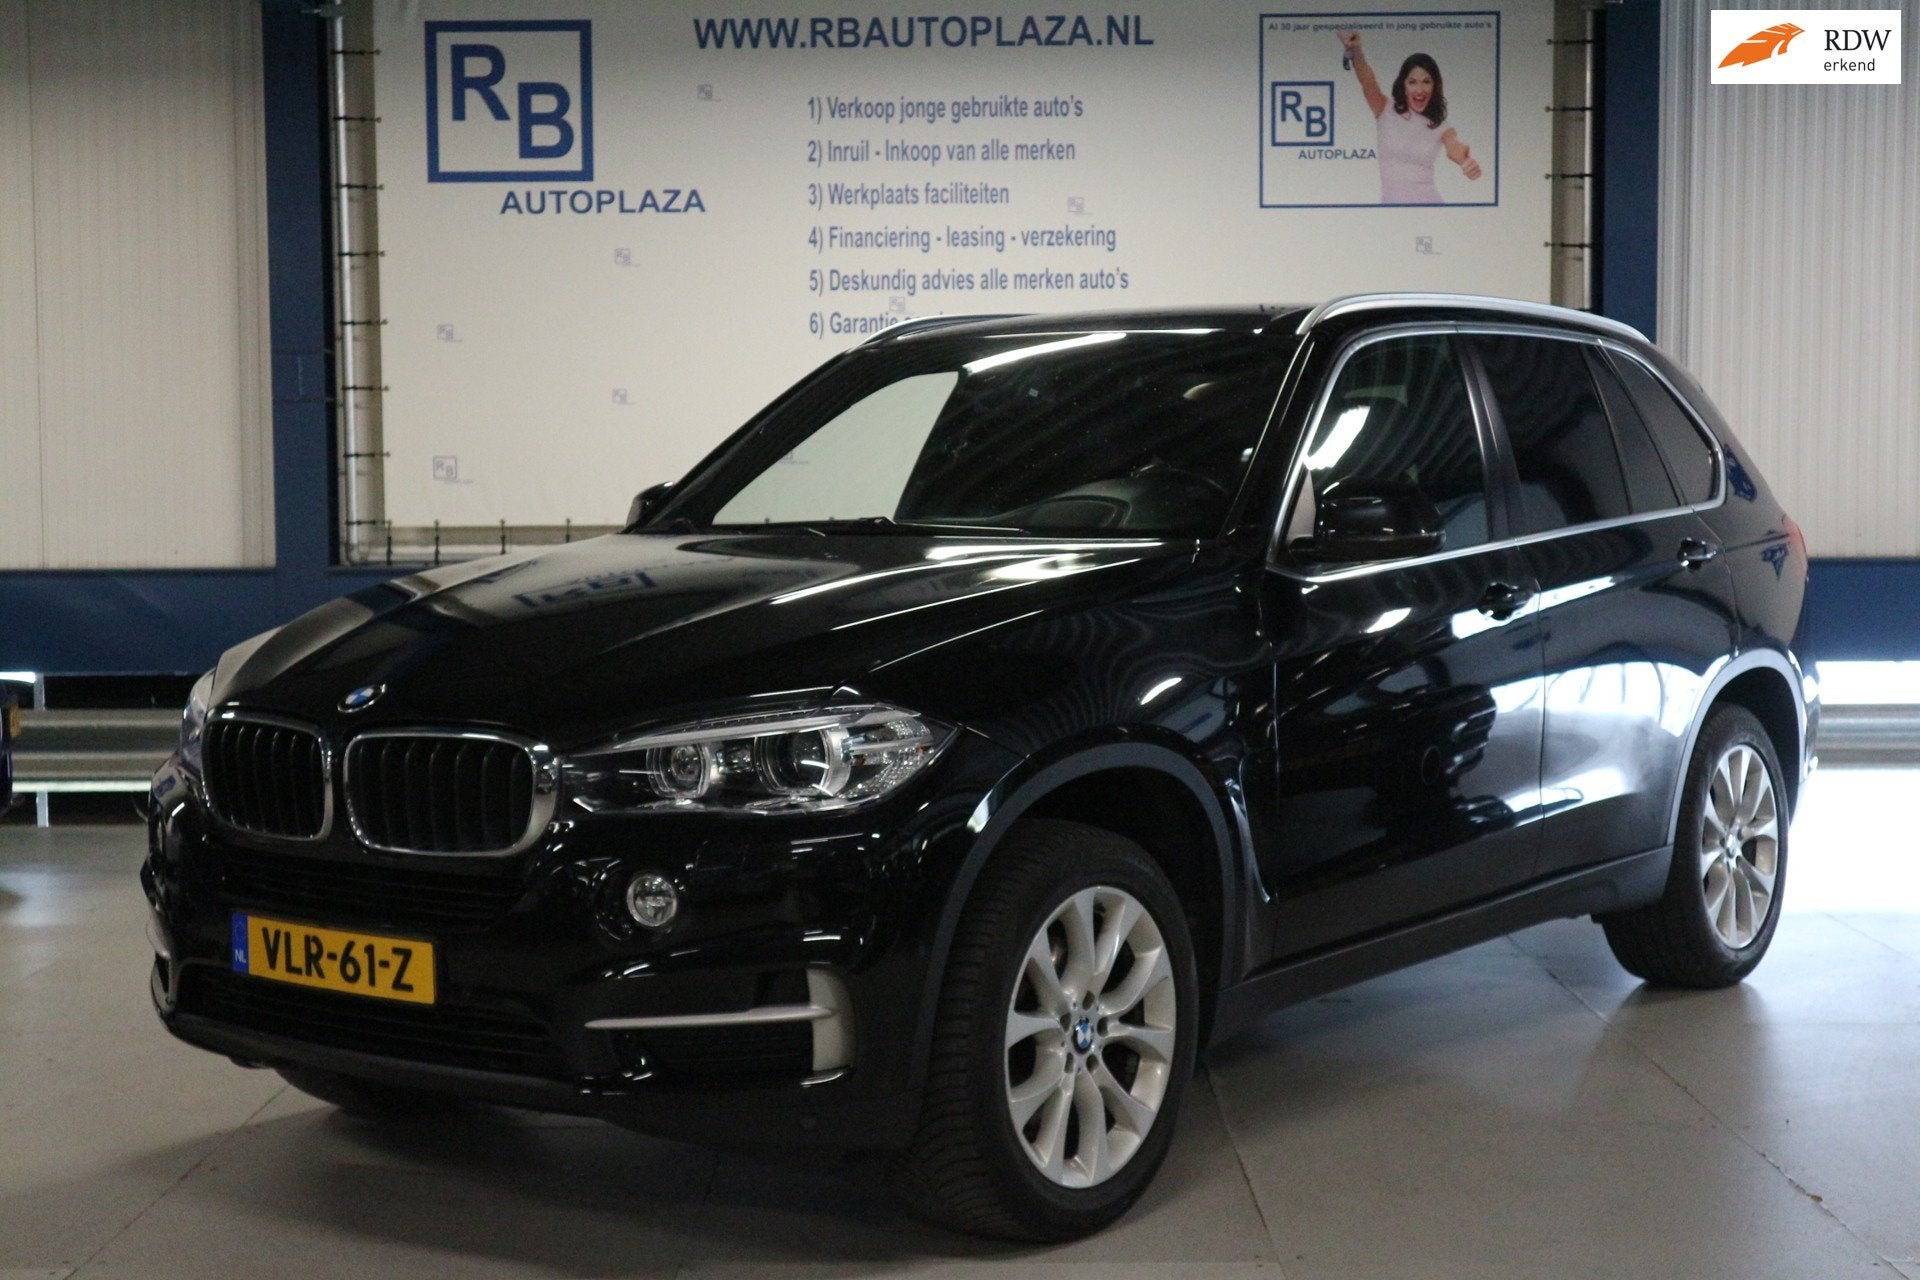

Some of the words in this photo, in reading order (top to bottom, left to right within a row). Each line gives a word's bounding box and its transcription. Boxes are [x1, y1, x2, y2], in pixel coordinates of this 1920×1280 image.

[694, 15, 1154, 49] WWW.RBAUTOPLAZA.NL
[1280, 22, 1291, 31] 30
[1293, 22, 1310, 32] jaar
[1312, 21, 1384, 32] gespecialiseerd
[1385, 21, 1395, 30] in
[1396, 21, 1417, 31] jong
[1419, 20, 1462, 31] gebruikte
[1464, 20, 1492, 29] auto's
[808, 97, 823, 124] 1)
[827, 97, 895, 123] Verkoop
[900, 97, 946, 123] jonge
[952, 96, 1028, 123] gebruikte
[1034, 95, 1084, 118] auto's
[808, 140, 823, 167] 2)
[828, 141, 869, 162] Inruil
[886, 140, 941, 166] Inkoop
[947, 145, 975, 161] van
[981, 139, 1009, 160] alle
[1015, 139, 1075, 160] merken
[1298, 148, 1377, 160] AUTOPLAZA
[500, 189, 706, 215] AUTOPLAZA
[809, 183, 823, 210] 3)
[828, 183, 919, 209] Werkplaats
[925, 182, 1010, 204] faciliteiten
[808, 226, 824, 253] 4)
[829, 226, 931, 253] Financiering
[947, 226, 1005, 253] leasing
[1021, 225, 1117, 251] verzekering
[809, 269, 824, 296] 5)
[829, 269, 916, 296] Deskundig
[922, 269, 975, 290] advies
[980, 268, 1008, 290] alle
[1014, 268, 1075, 290] merken
[1080, 267, 1129, 289] auto's
[809, 312, 824, 339] 6)
[235, 949, 247, 963] NL
[262, 926, 414, 993] VLR-61-Z
